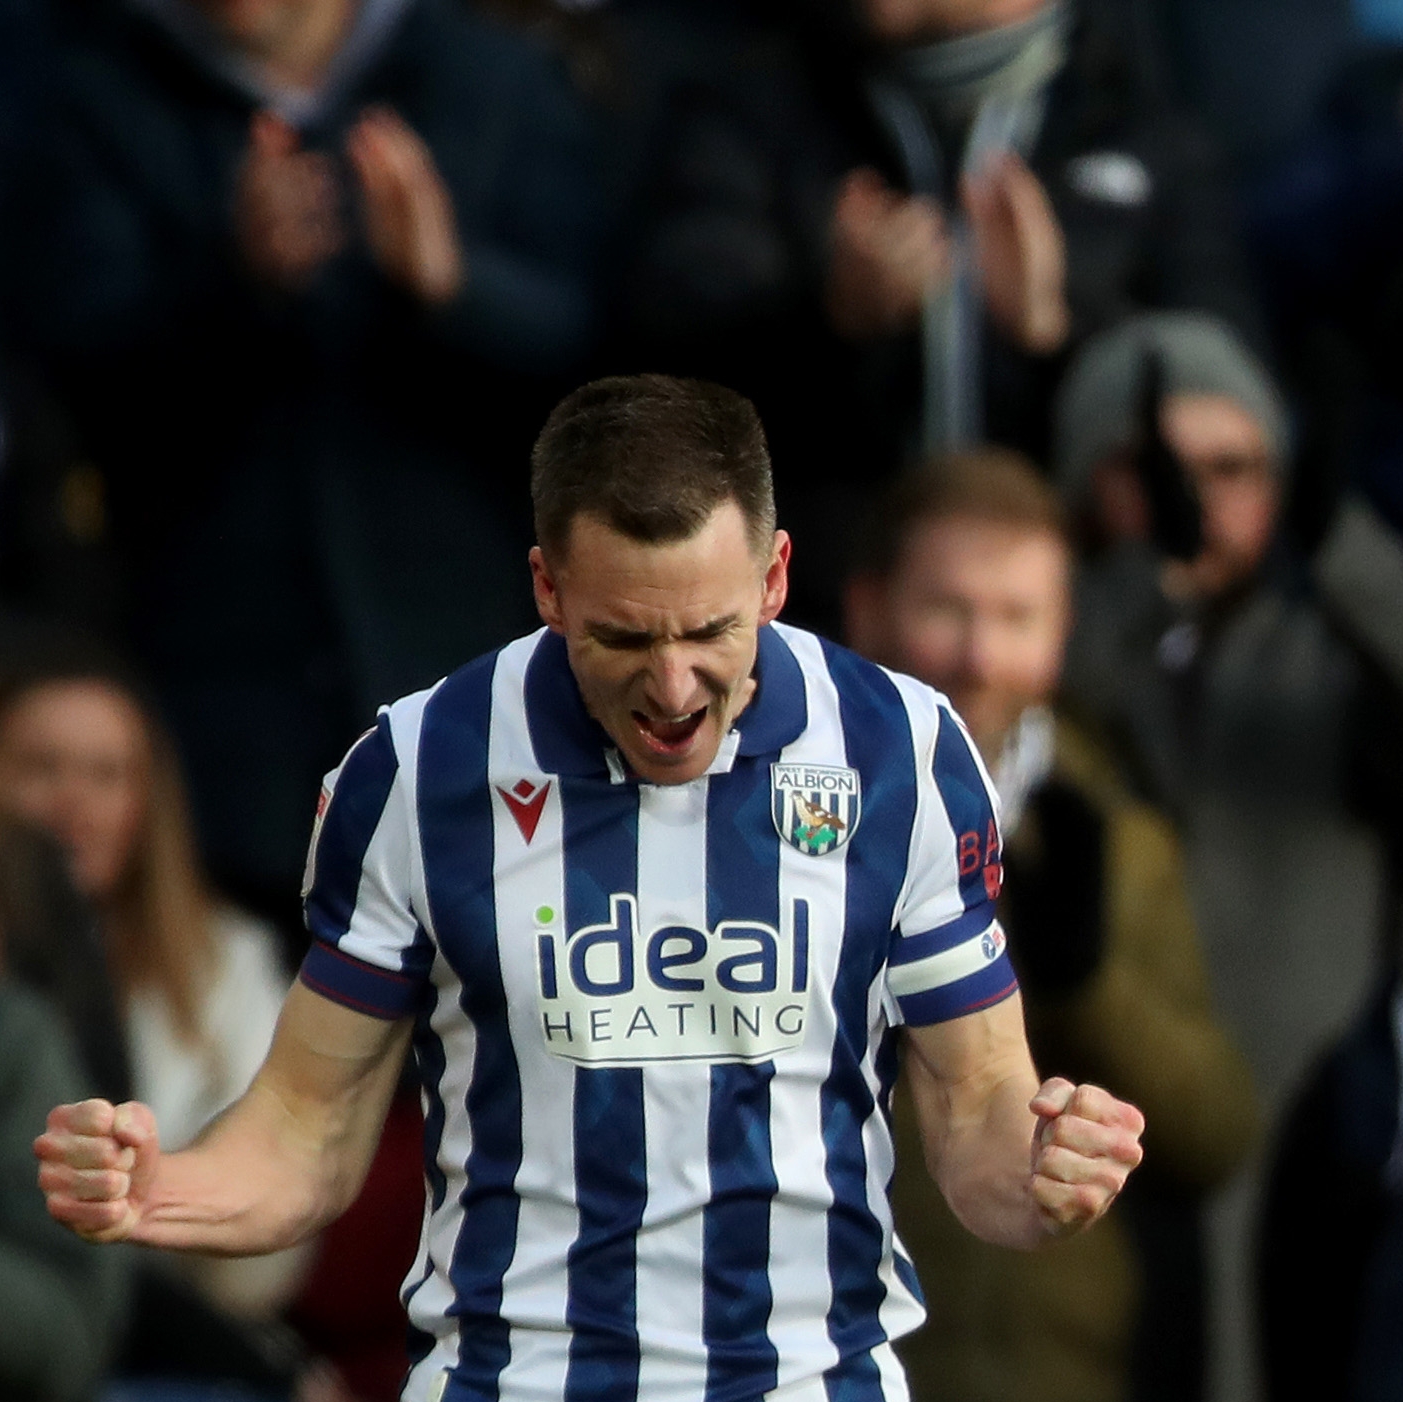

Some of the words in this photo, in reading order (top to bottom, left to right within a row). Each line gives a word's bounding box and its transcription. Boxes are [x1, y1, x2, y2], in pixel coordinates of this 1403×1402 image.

[778, 773, 853, 791] ALBION
[536, 898, 809, 1000] ideal
[543, 1003, 804, 1042] HEATING
